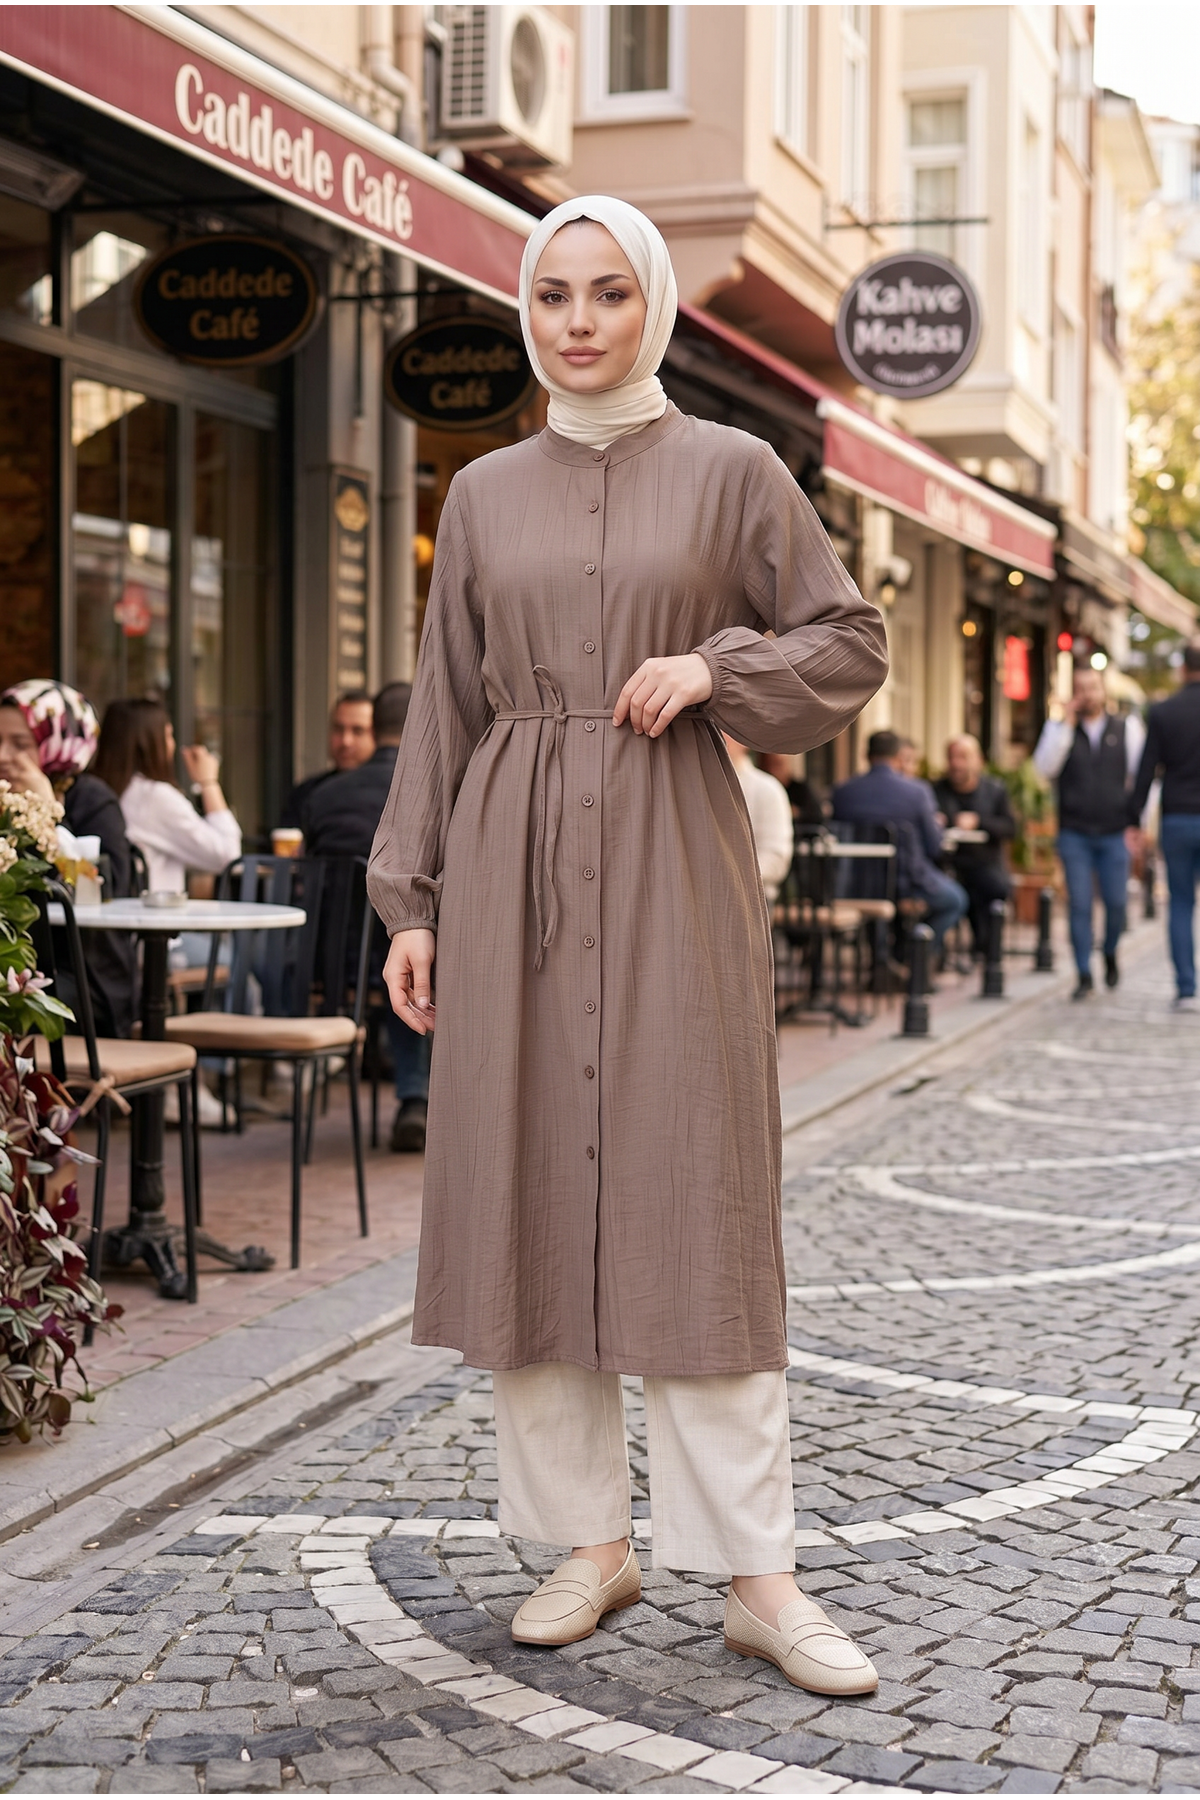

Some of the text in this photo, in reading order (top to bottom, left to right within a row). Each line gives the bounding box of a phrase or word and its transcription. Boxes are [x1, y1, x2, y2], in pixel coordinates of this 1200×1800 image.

[175, 63, 413, 240] Caddede Café
[158, 267, 294, 300] Caddede
[857, 276, 962, 315] Kahve
[189, 306, 260, 340] Café
[853, 317, 963, 355] Molası
[402, 343, 519, 376] Caddede
[430, 378, 491, 409] Café
